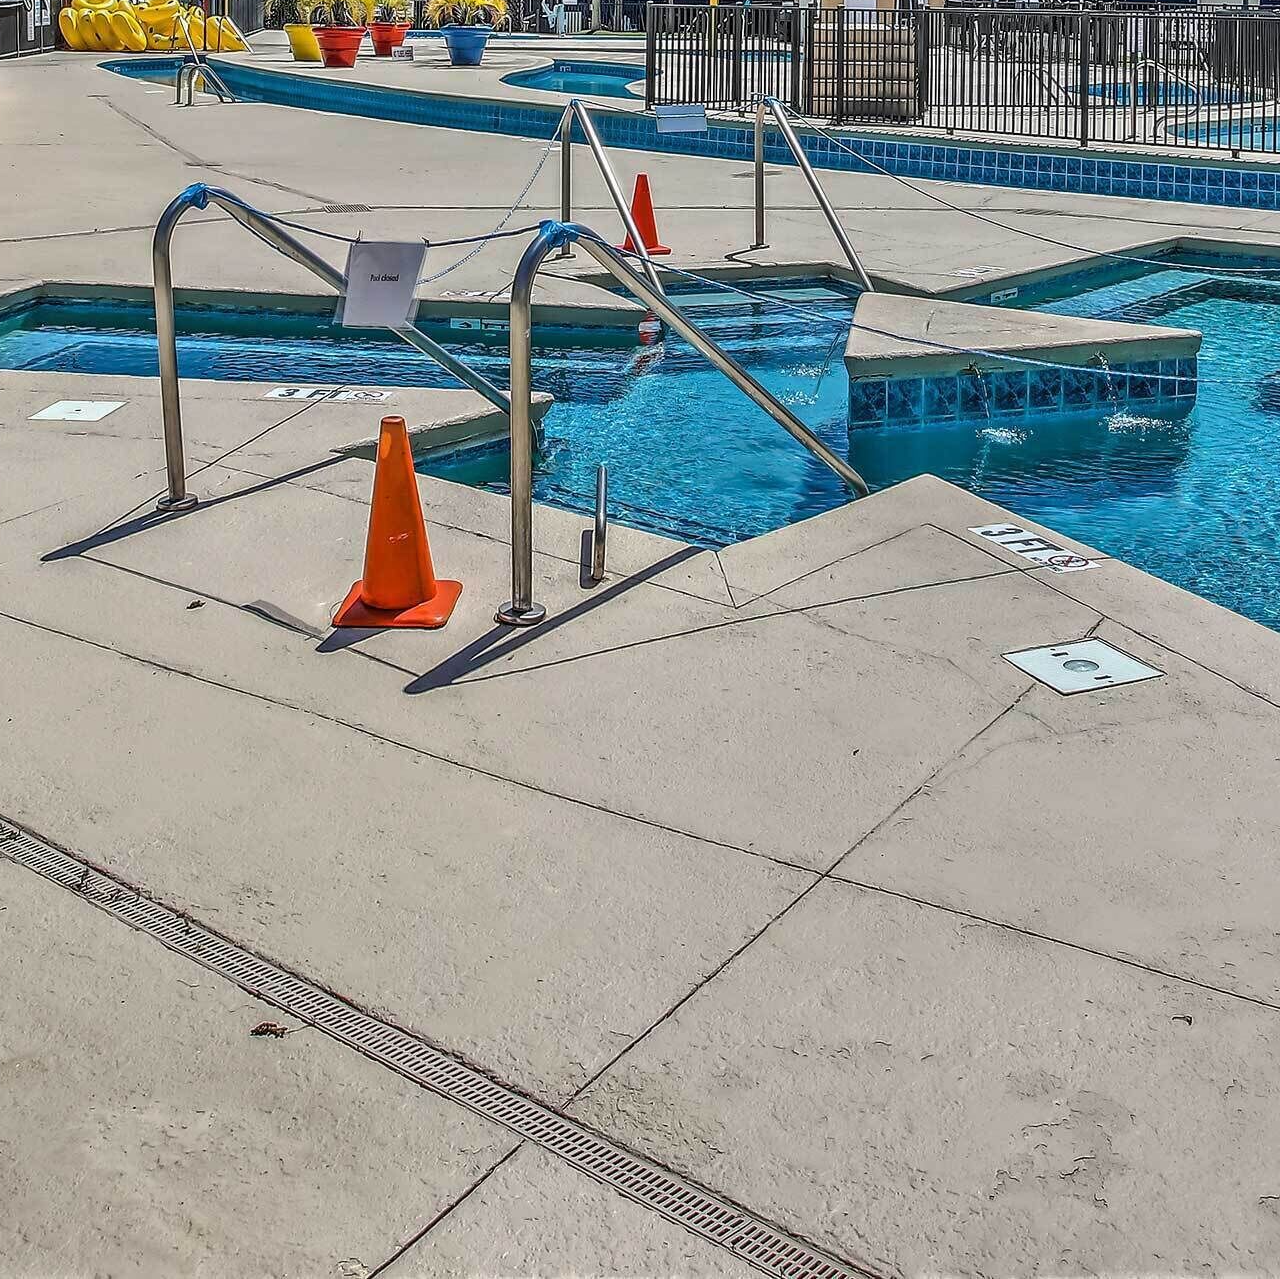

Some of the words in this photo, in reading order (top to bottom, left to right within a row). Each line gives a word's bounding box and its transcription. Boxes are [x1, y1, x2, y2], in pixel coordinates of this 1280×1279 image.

[381, 273, 399, 282] closed
[278, 388, 300, 397] 3
[306, 389, 350, 399] FT
[980, 527, 1024, 537] 3
[1000, 537, 1065, 553] FT
